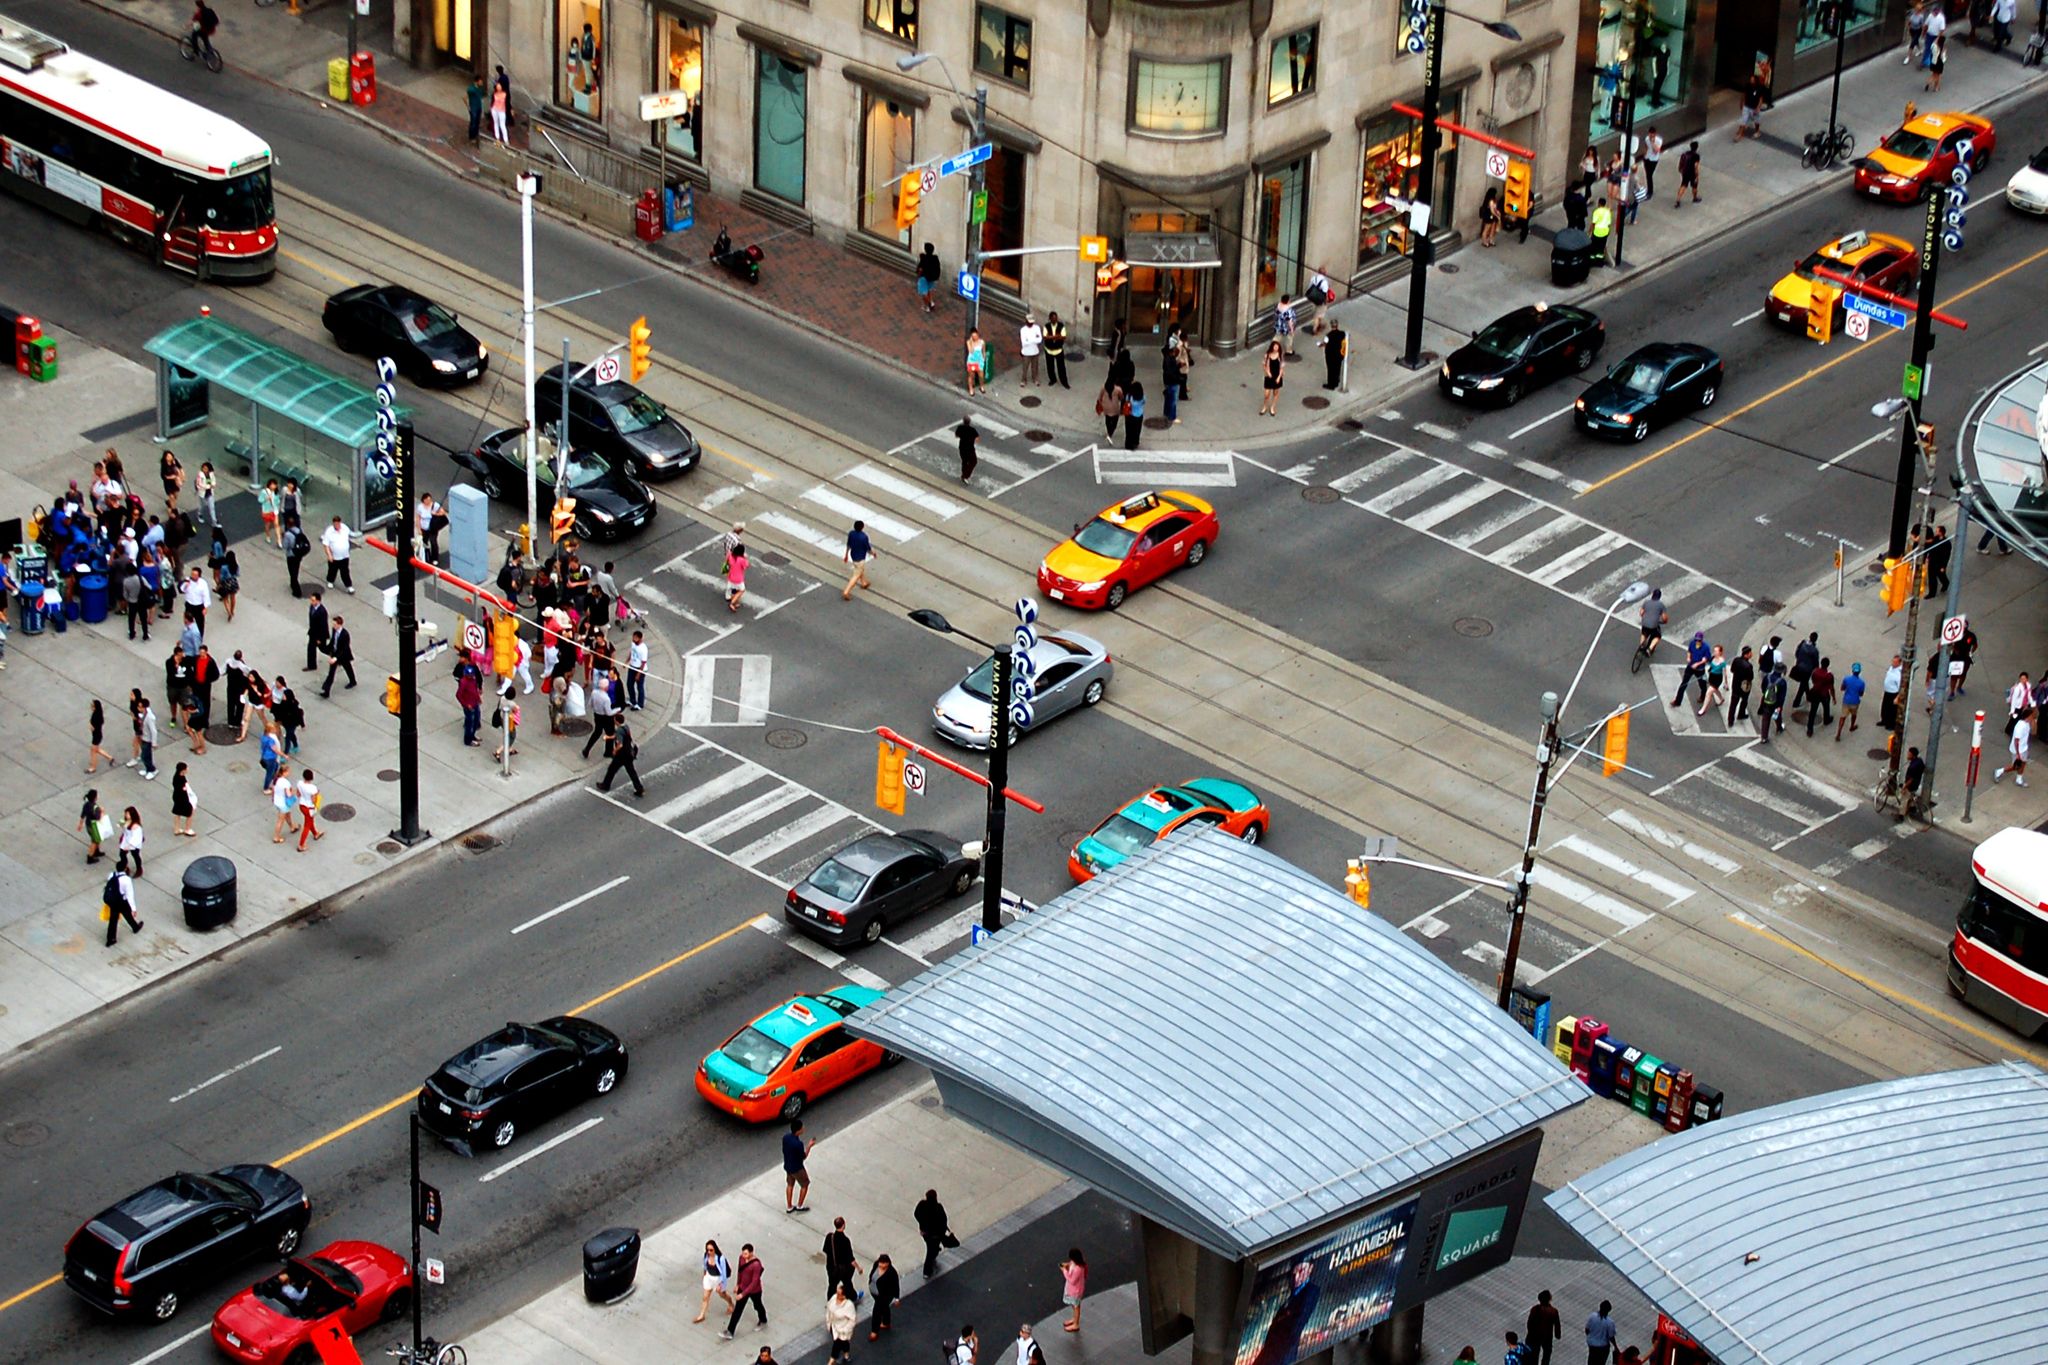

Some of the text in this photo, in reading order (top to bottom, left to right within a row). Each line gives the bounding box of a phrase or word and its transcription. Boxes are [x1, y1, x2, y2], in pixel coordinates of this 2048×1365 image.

[1425, 13, 1436, 87] DOWNTOWN
[1152, 244, 1196, 261] XXI
[1922, 192, 1938, 271] DOWNTOWN
[1854, 297, 1887, 319] Dundas
[396, 435, 404, 520] DOWNTOWN
[989, 659, 1001, 749] DOWNTOWN
[1454, 1166, 1518, 1204] DUNDAS
[1328, 1221, 1406, 1270] HANNIBAL
[1441, 1230, 1500, 1266] SQUARE
